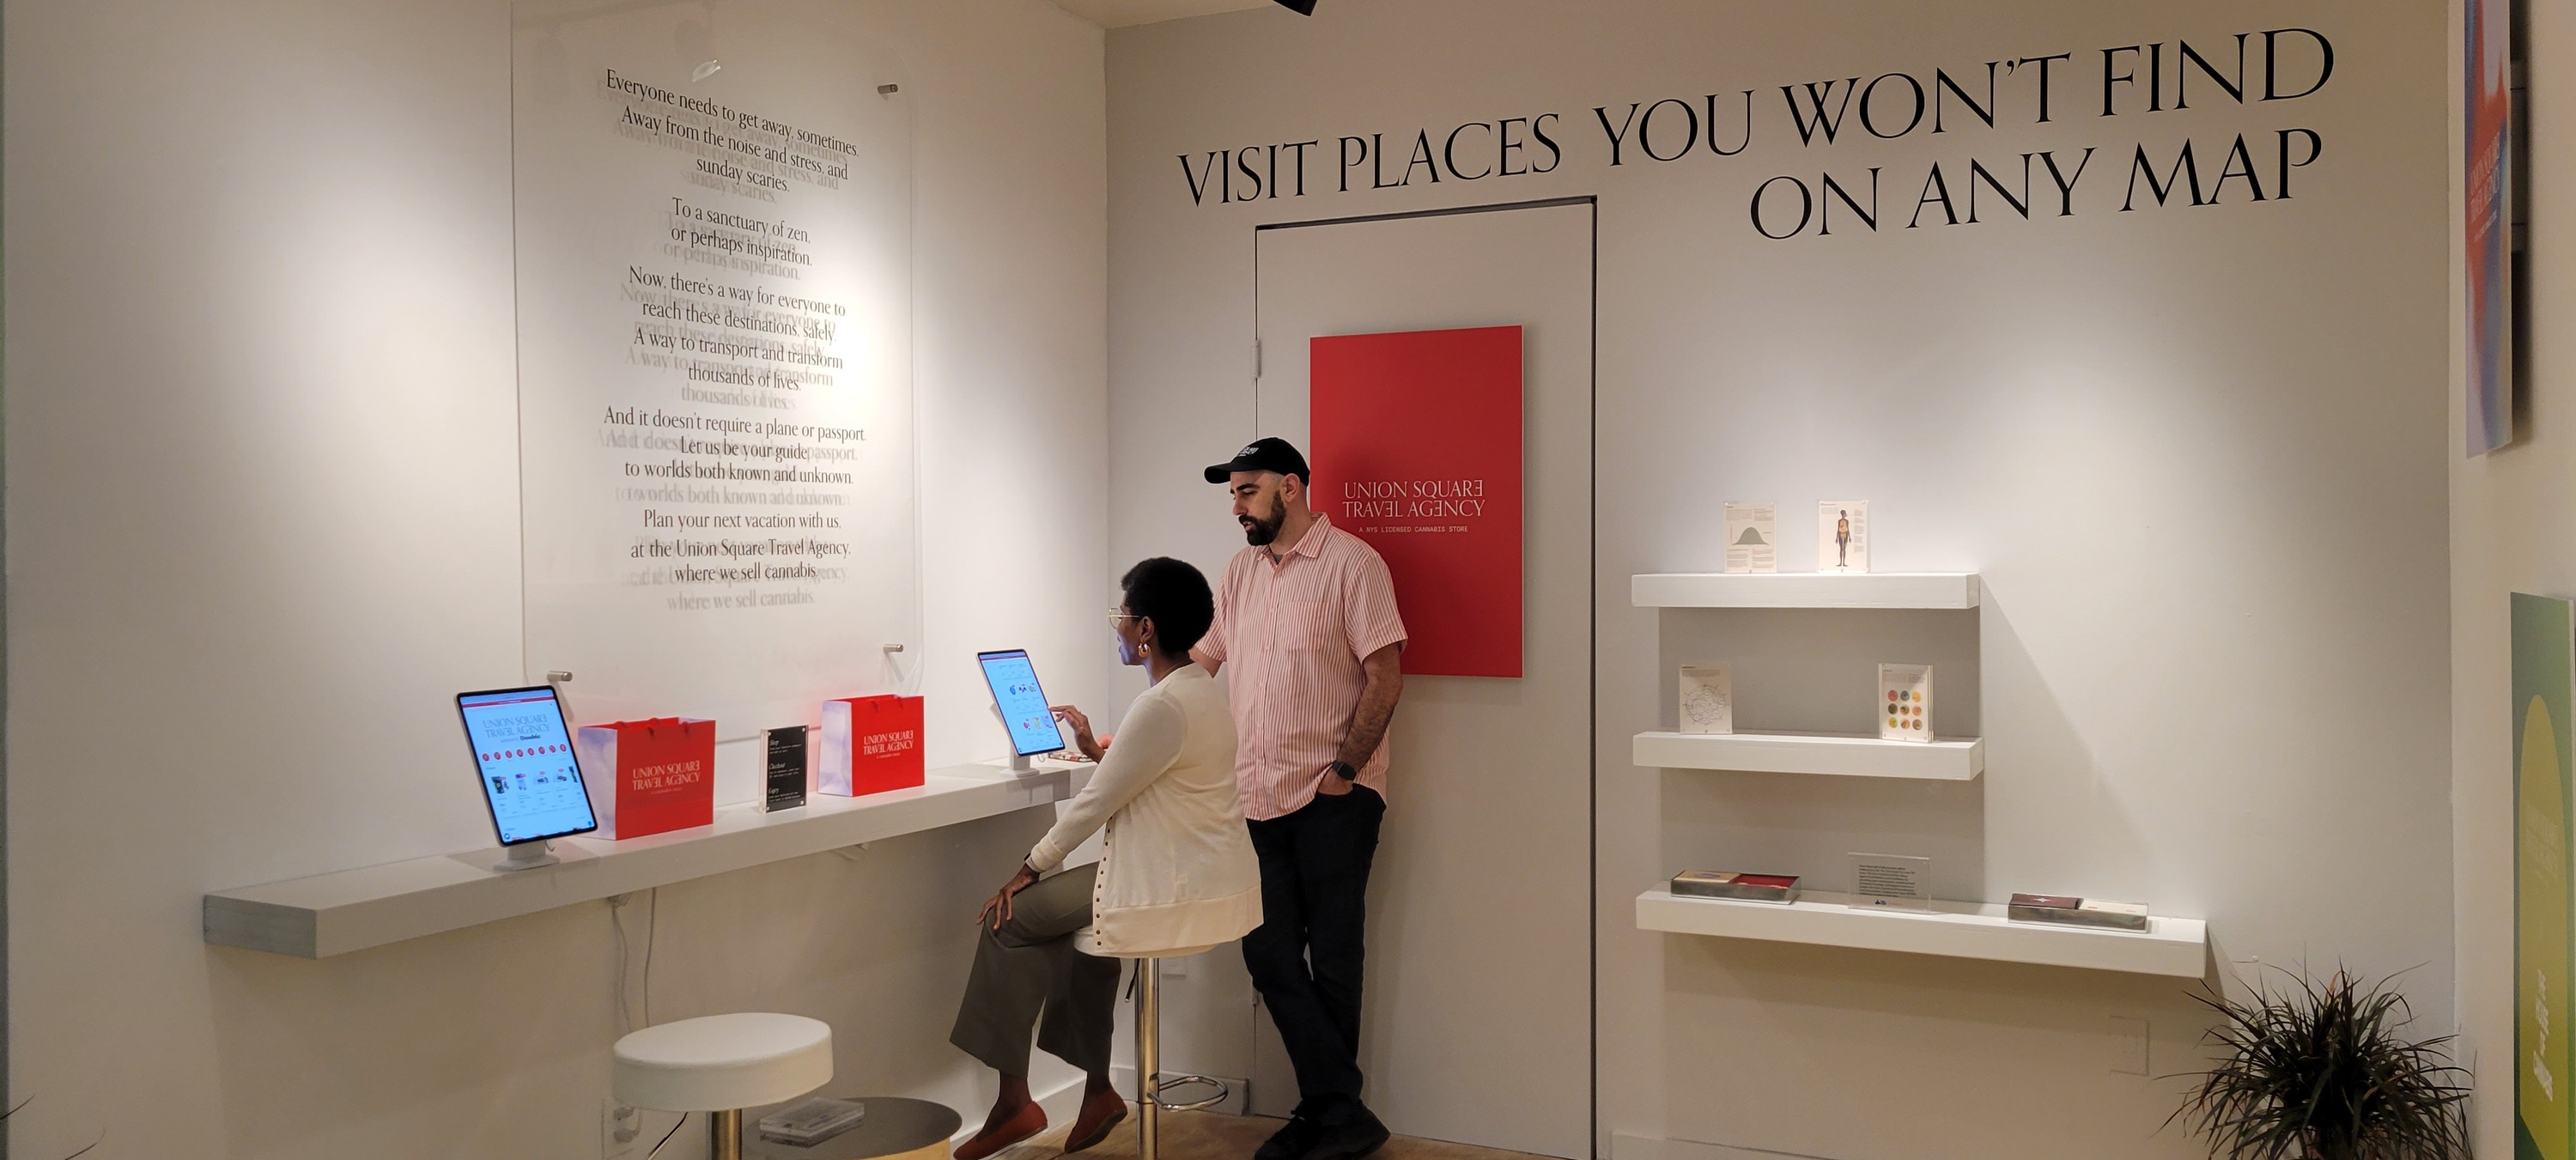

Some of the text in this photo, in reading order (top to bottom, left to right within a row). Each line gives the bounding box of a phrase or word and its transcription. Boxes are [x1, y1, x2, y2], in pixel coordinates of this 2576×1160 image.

[607, 69, 674, 105] Everyone
[679, 96, 718, 117] needs
[722, 105, 735, 121] to
[739, 112, 758, 129] get
[1178, 29, 2333, 206] VISIT PLACES YOU WON'T FIND
[622, 105, 661, 136] Away
[666, 115, 699, 141] from
[703, 126, 724, 147] the
[728, 137, 761, 156] noise
[764, 147, 787, 164] and
[828, 163, 848, 179] and
[696, 158, 790, 191] sunday scaries.
[1751, 129, 2321, 239] ON ANY MAP
[672, 197, 691, 218] To
[695, 208, 702, 221] a
[707, 210, 769, 238] sanctuary
[772, 221, 785, 237] of
[671, 228, 812, 266] or perhaps inspiration.
[671, 272, 714, 296] there's
[718, 285, 725, 298] a
[728, 287, 753, 307] way
[757, 286, 775, 305] for
[778, 295, 830, 315] everyone
[834, 302, 846, 316] to
[642, 301, 681, 320] reach
[686, 303, 720, 325] these
[634, 326, 842, 369] A way to transport and transform
[689, 361, 801, 392] thousands of lives.
[604, 405, 866, 444] And it doesn't require a plane or passport.
[681, 436, 702, 453] Let
[705, 442, 720, 455] us
[724, 438, 739, 456] be
[744, 444, 772, 461] your
[625, 461, 640, 476] to
[644, 459, 691, 478] worlds
[696, 460, 726, 480] both
[730, 462, 770, 481] known
[774, 465, 796, 482] and
[1345, 479, 1484, 499] UNION SQUARE
[644, 509, 673, 527] Plan
[677, 515, 710, 532] your
[714, 513, 741, 527] next
[745, 513, 795, 527] vacation
[799, 512, 823, 527] with
[1342, 500, 1485, 518] TRAVEL AGENCY
[631, 544, 644, 557] at
[650, 539, 671, 557] the
[677, 539, 717, 556] Union
[721, 538, 764, 561] Square
[769, 538, 804, 555] Travel
[675, 561, 818, 581] where we sell cannabis.
[483, 714, 548, 728] UNION SQUARE
[484, 723, 550, 738] TRAVEL AGENCY
[864, 730, 914, 744] UNION SQUARE
[864, 739, 914, 755] TRAVEL AGENCY
[632, 760, 700, 779] UNION SQUARE
[632, 777, 664, 791] TRAVEL
[665, 772, 701, 786] AGENCY
